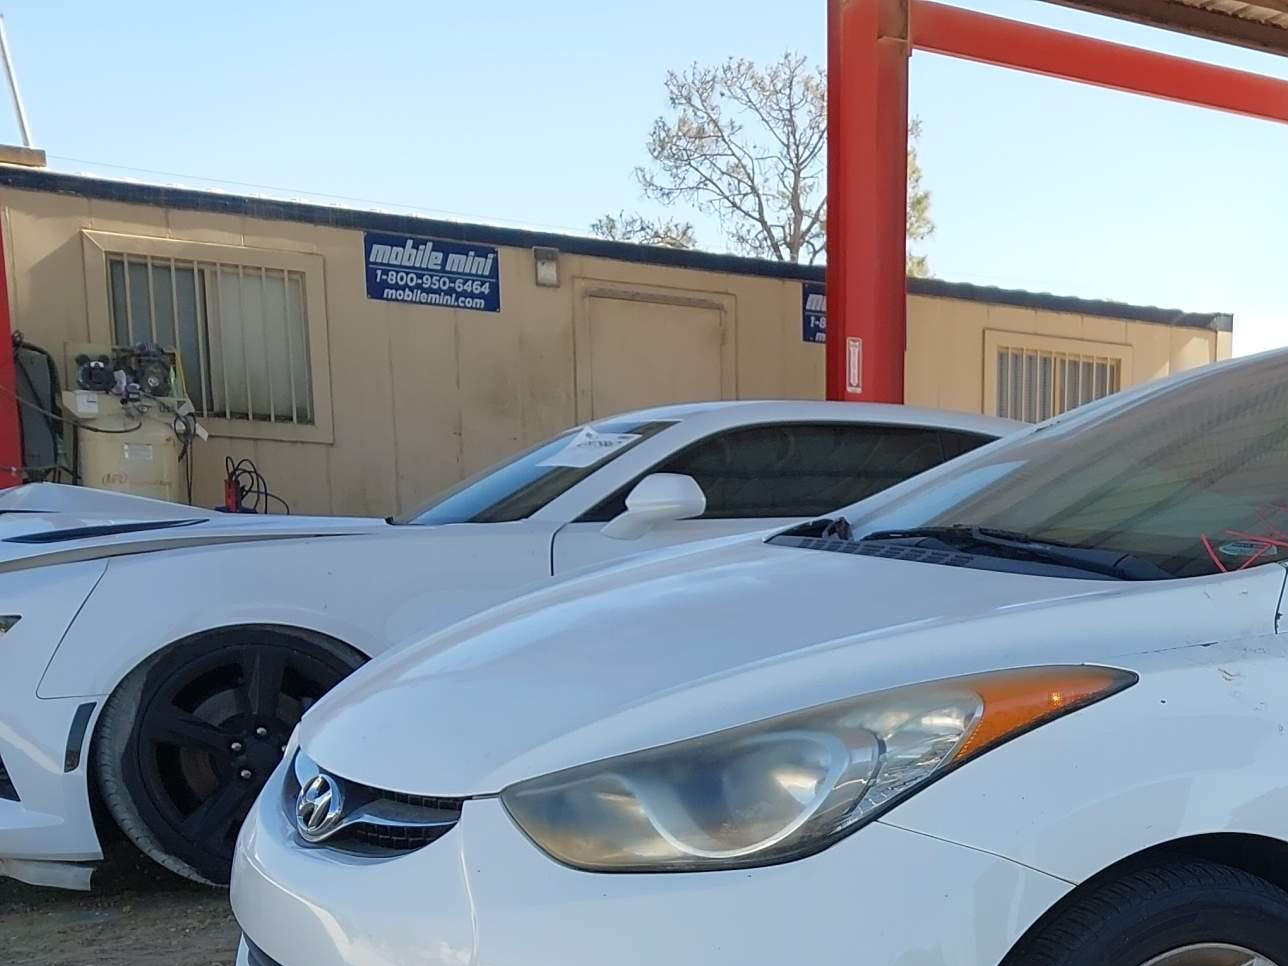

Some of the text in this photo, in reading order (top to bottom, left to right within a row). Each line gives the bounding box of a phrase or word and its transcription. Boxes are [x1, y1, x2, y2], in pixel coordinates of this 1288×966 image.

[369, 239, 495, 276] mobile mini
[375, 269, 490, 295] 1-800-950-6464
[383, 287, 485, 309] mobilemini.com
